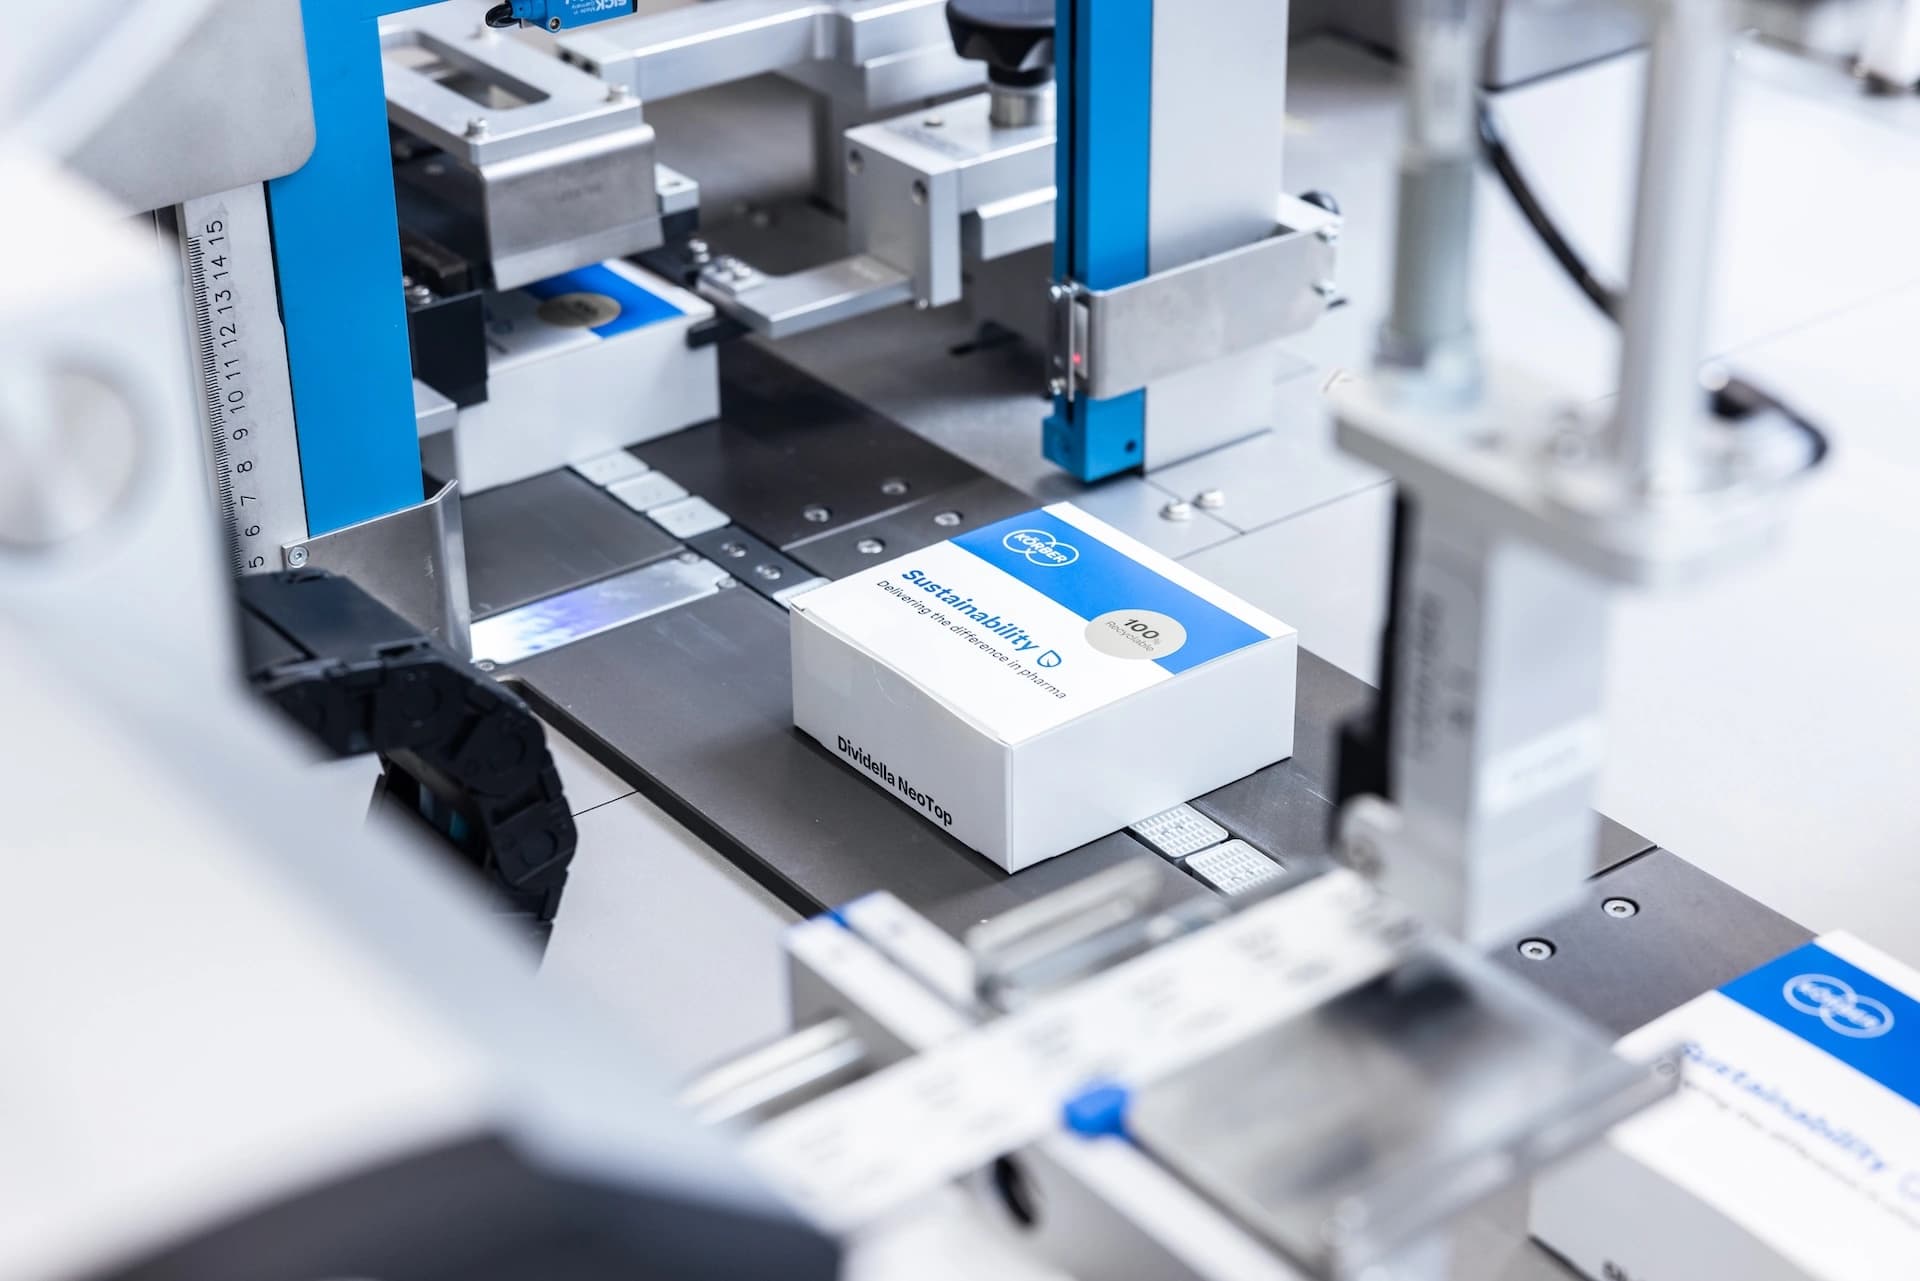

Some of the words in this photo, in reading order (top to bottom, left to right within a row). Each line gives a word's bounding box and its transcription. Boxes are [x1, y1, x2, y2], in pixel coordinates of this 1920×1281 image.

[206, 220, 225, 245] 15
[211, 255, 229, 280] 14
[215, 289, 233, 314] 13
[219, 323, 238, 348] 12
[224, 358, 241, 380] 11
[227, 390, 246, 414] 10
[232, 428, 249, 441] 9
[236, 460, 253, 474] 8
[240, 495, 257, 507] 7
[244, 525, 261, 537] 6
[1013, 533, 1068, 563] KÖRBER
[248, 556, 264, 569] 5
[901, 569, 1040, 652] Sustainability
[876, 580, 932, 616] Delivering
[931, 611, 951, 627] the
[949, 623, 1009, 663] difference
[1007, 659, 1022, 671] in
[1017, 667, 1067, 700] pharma
[1105, 620, 1155, 652] Recyclable
[837, 735, 895, 787] Dividella
[898, 775, 953, 827] NeoTop
